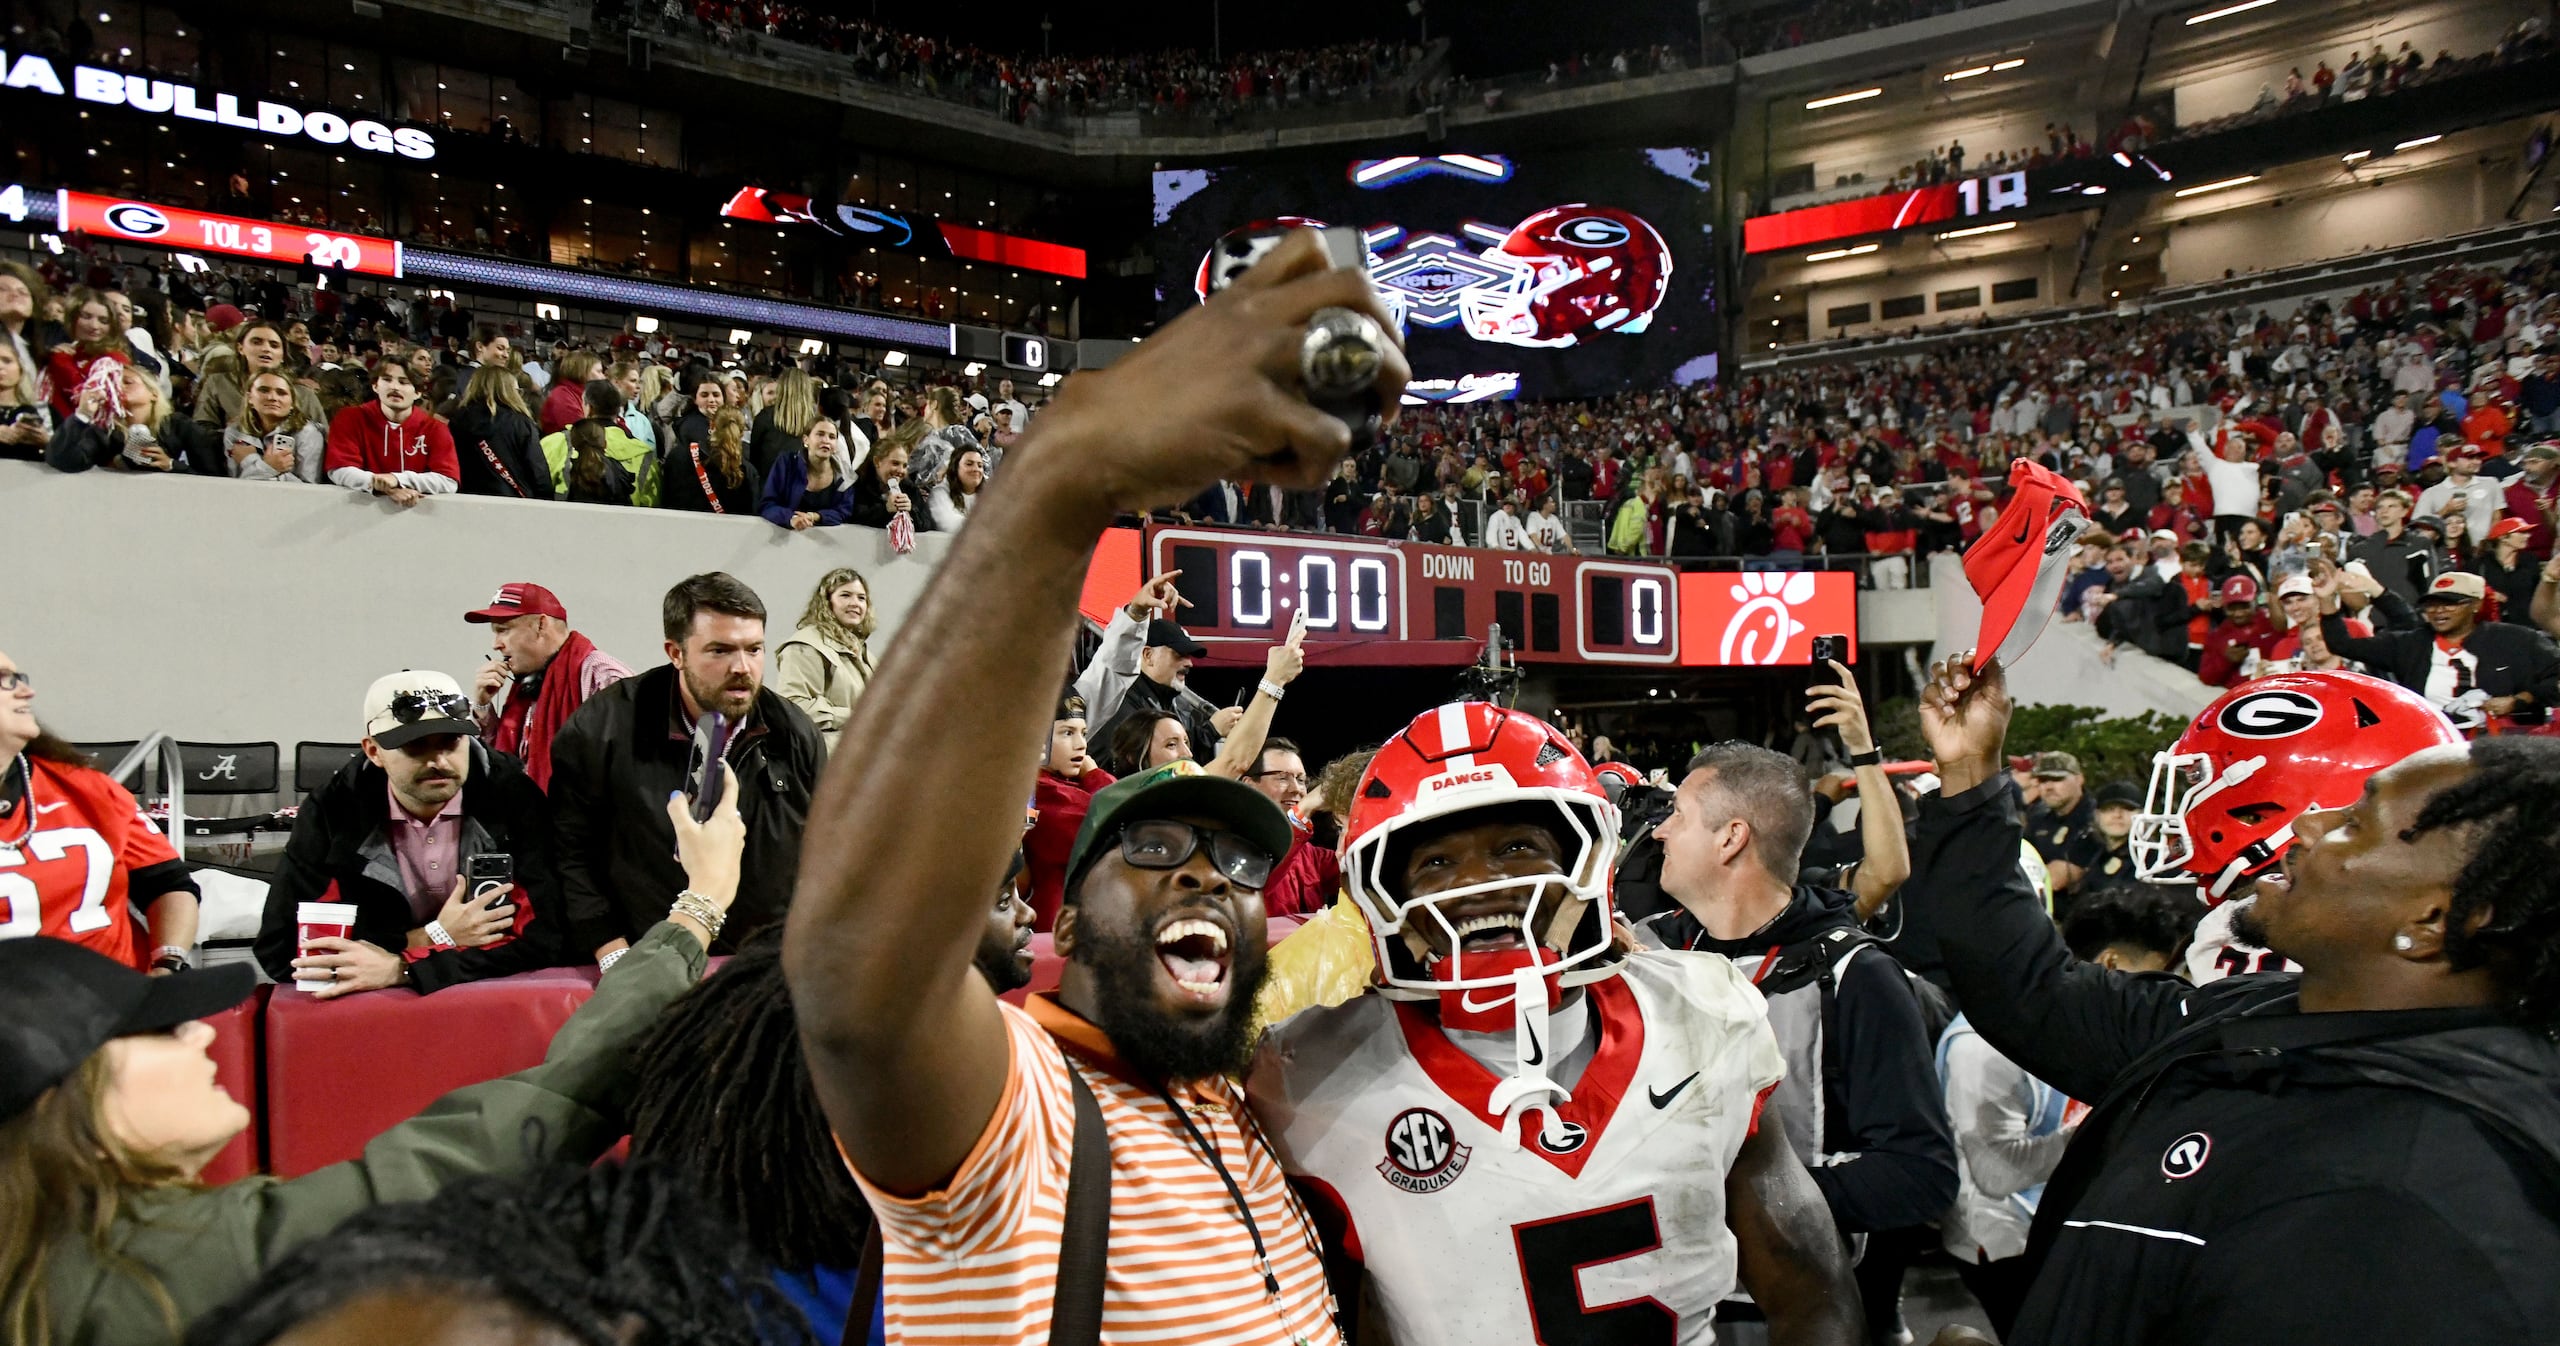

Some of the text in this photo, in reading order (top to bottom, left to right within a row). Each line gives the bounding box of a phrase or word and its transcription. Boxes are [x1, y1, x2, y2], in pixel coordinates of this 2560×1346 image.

[74, 65, 436, 160] BULLDOGS
[199, 219, 273, 254] TOL 3
[305, 232, 361, 271] 20
[1026, 340, 1042, 367] 0
[1505, 529, 1516, 547] 2
[1540, 527, 1553, 547] 12
[1423, 553, 1475, 581] DOWN
[1503, 559, 1551, 587] TO GO
[1231, 550, 1388, 630] 0:00
[1631, 578, 1663, 645] 0
[2216, 690, 2323, 739] G
[1432, 770, 1494, 792] DAWGS
[1390, 1112, 1450, 1172] SEC
[1391, 1160, 1463, 1191] GRADUATE
[1511, 1195, 1679, 1346] 5
